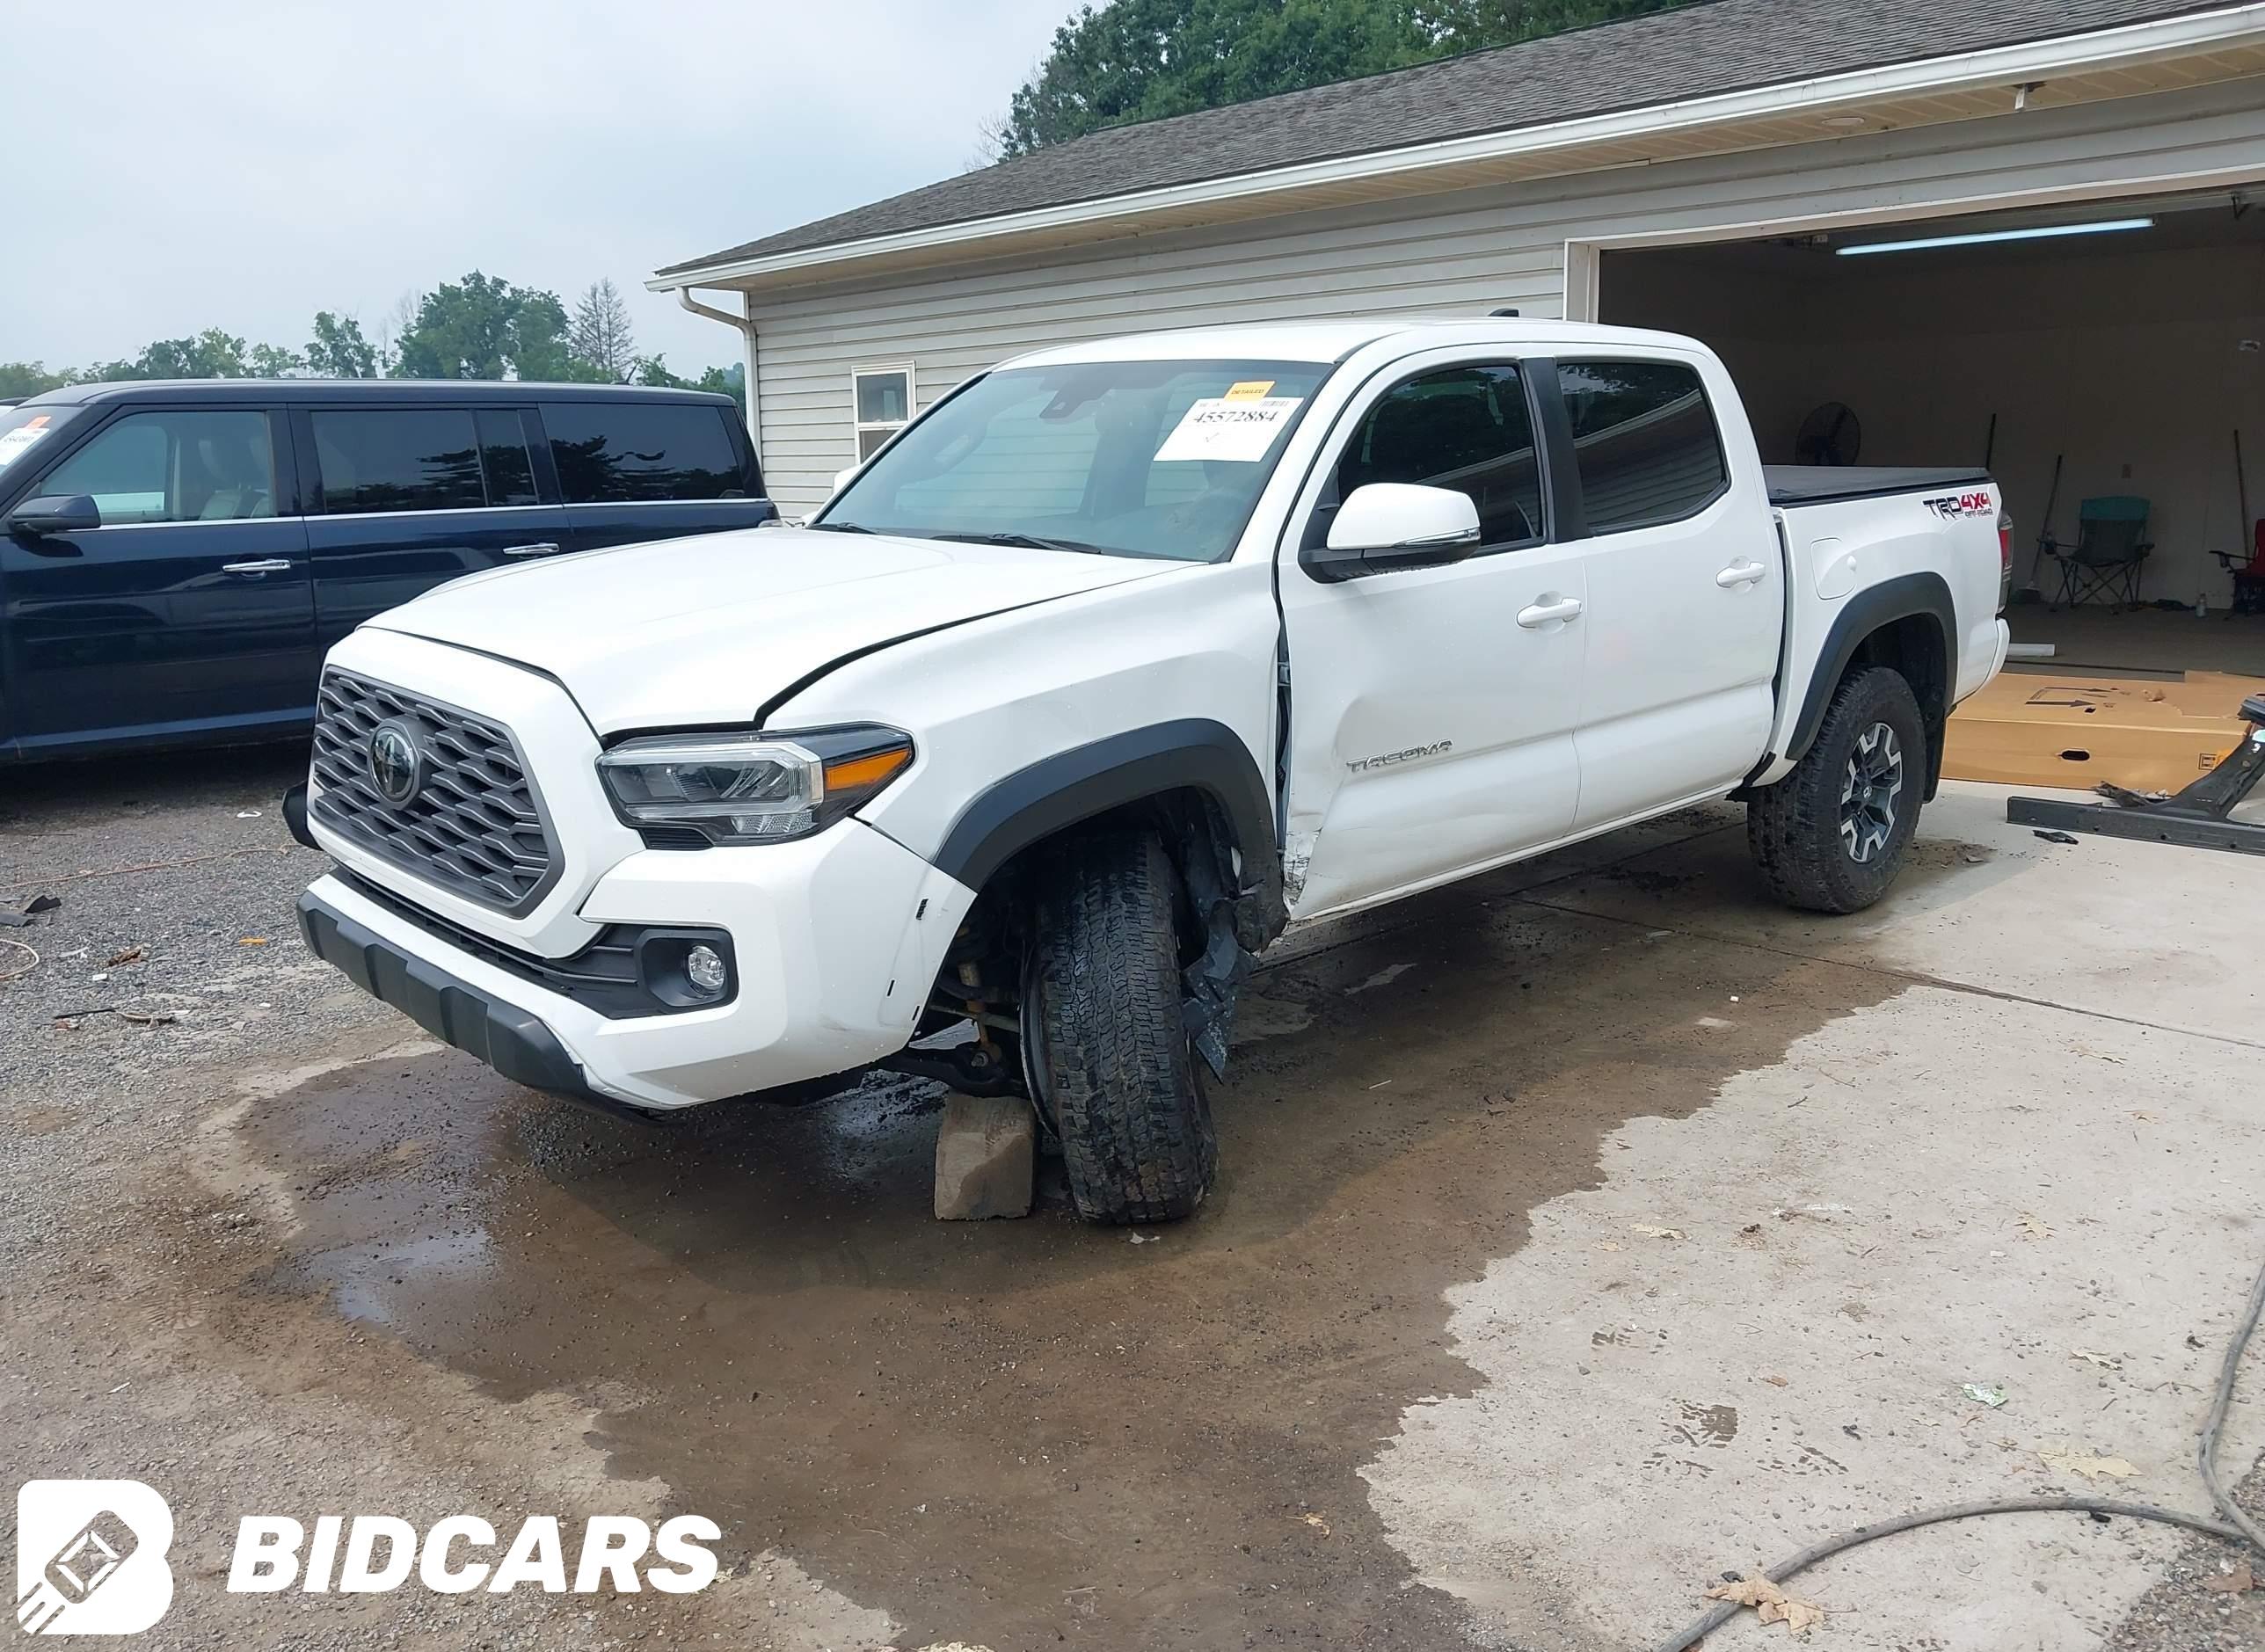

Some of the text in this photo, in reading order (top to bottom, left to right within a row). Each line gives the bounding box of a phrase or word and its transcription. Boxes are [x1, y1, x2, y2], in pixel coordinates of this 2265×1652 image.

[1193, 411, 1278, 423] 45572884
[1977, 508, 1993, 517] ROAD
[1346, 739, 1453, 772] TACOMA
